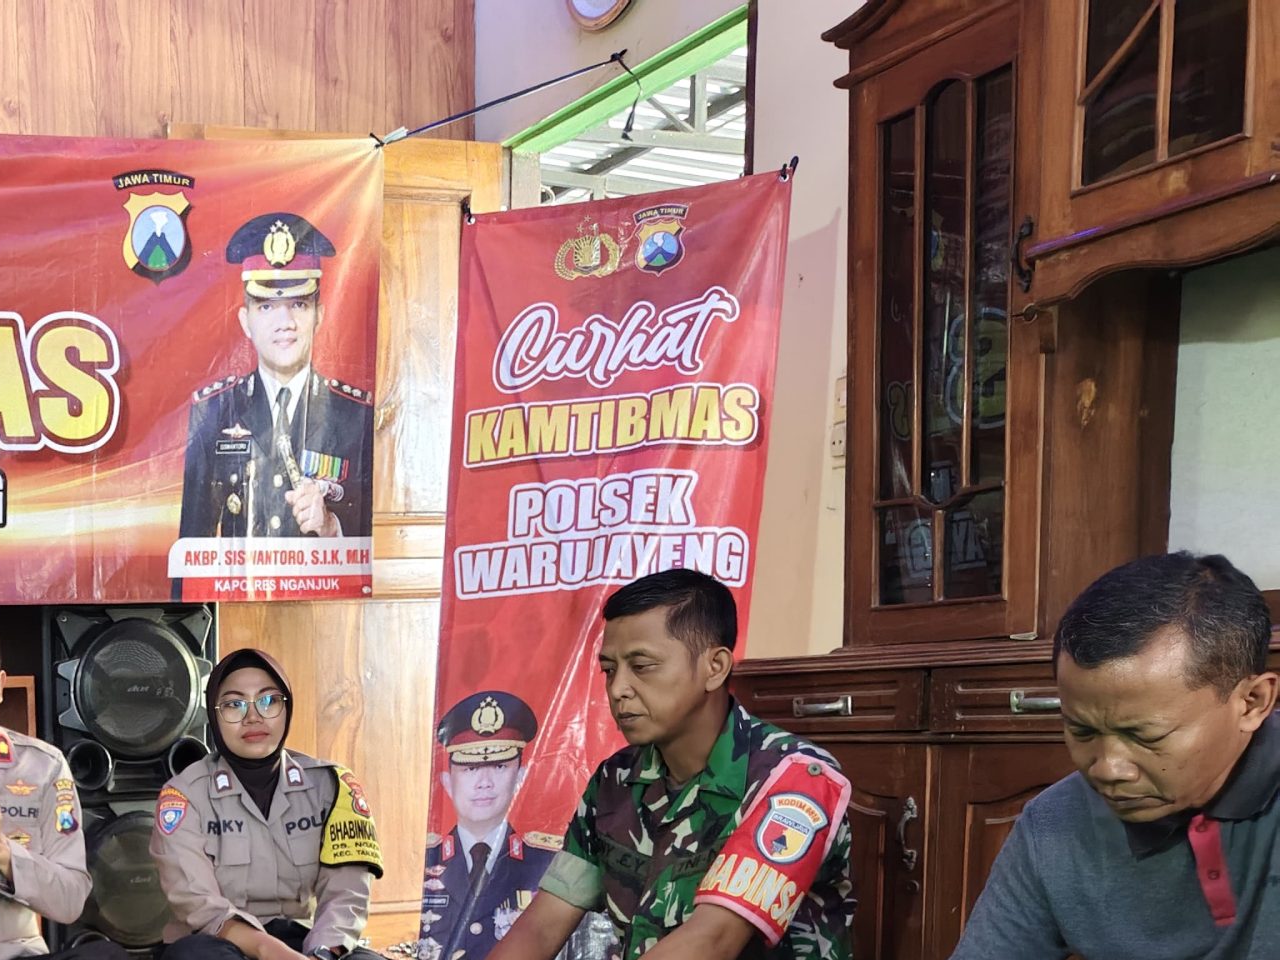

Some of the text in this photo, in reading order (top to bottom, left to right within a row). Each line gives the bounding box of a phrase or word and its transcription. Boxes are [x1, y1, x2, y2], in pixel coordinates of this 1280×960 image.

[118, 173, 190, 188] JAWA TIMUR
[493, 286, 738, 393] Curhat
[463, 385, 758, 468] KAMTIBMAS
[510, 470, 698, 540] POLSEK
[279, 578, 340, 591] NGANJUK
[778, 798, 807, 811] KODIM
